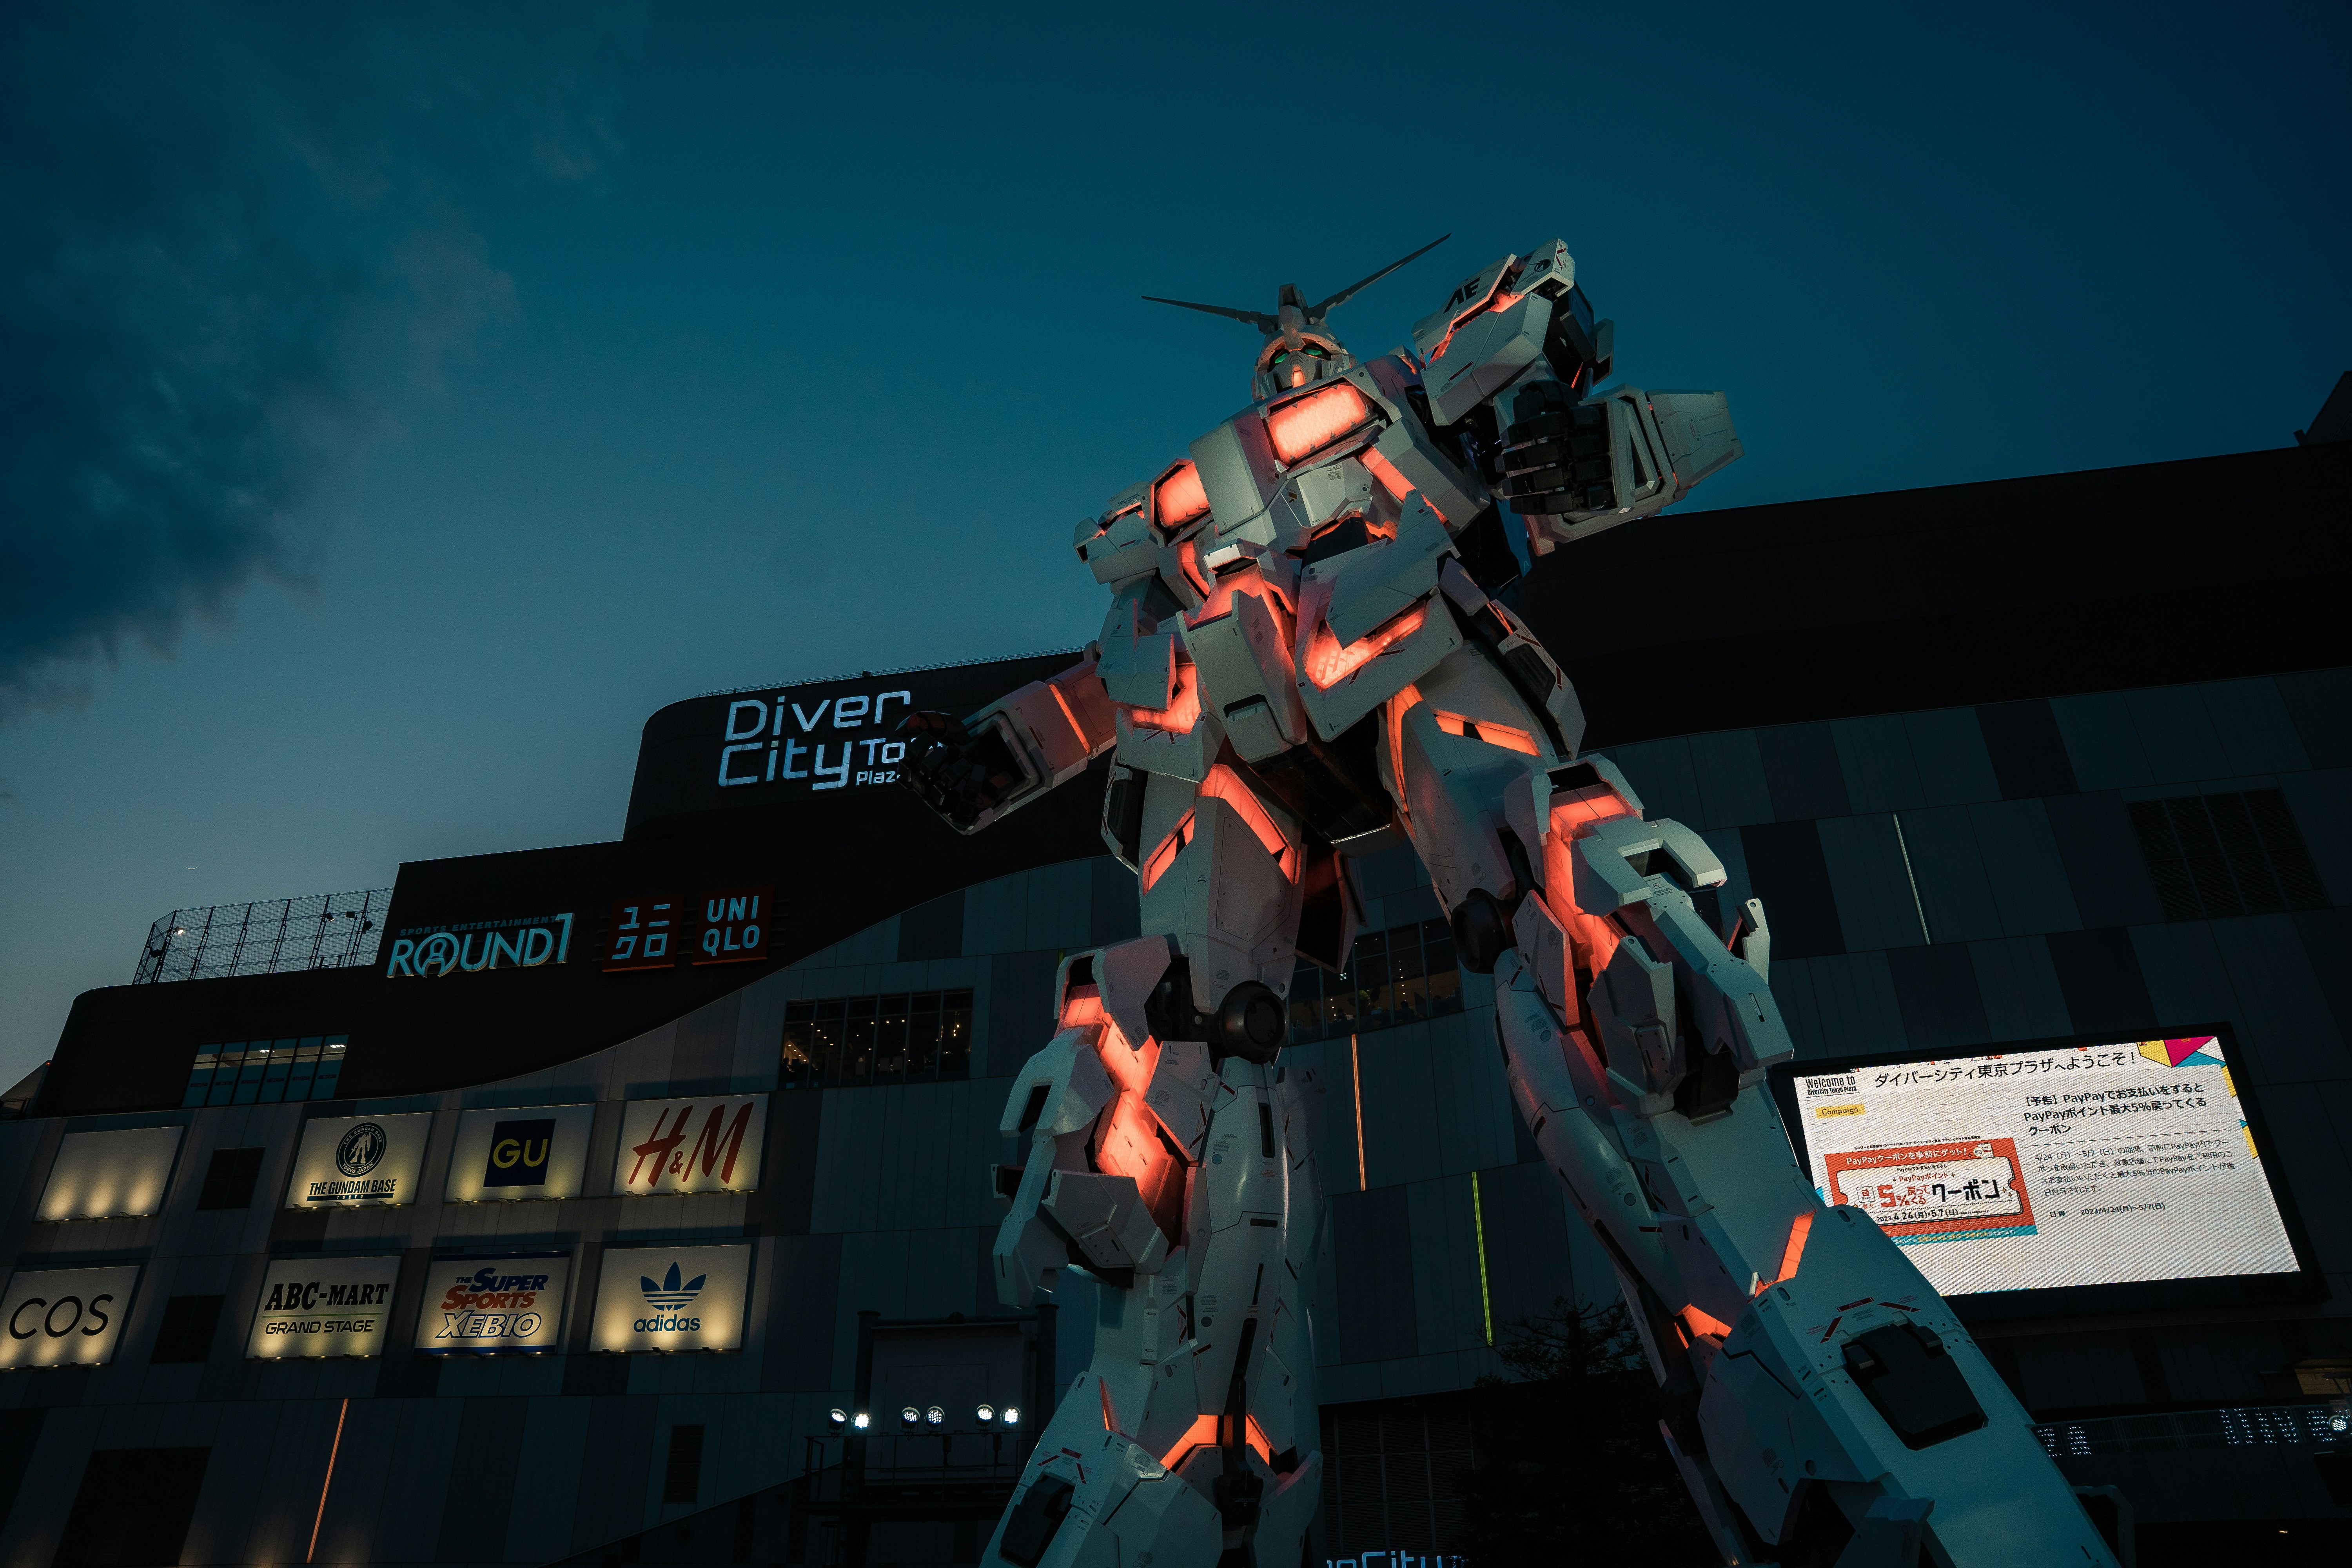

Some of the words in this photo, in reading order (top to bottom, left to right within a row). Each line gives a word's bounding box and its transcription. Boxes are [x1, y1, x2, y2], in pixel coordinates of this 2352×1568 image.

[724, 690, 911, 741] Diver
[718, 738, 853, 793] City
[855, 769, 901, 787] Plaz
[707, 895, 759, 922] UNI
[399, 925, 447, 936] SPORTS
[452, 915, 557, 931] ENTERTAINMENT
[387, 912, 575, 978] ROUND1
[702, 925, 760, 956] QLO
[1805, 1077, 1844, 1089] Welcome
[1846, 1075, 1856, 1085] to
[1875, 1051, 2135, 1088] ダイバーシティ東京プラザへようこそ！
[343, 1134, 352, 1145] THE
[354, 1127, 375, 1135] GUNDAM
[374, 1130, 383, 1143] BASE
[2028, 1123, 2071, 1136] クーポン
[492, 1138, 548, 1169] GU
[628, 1102, 754, 1187] H&M
[1846, 1147, 1967, 1165] PayPayクーポンを事前にゲット！
[342, 1163, 356, 1174] TOKYO
[357, 1162, 374, 1174] JAPAN
[1899, 1172, 1949, 1182] PayPayポイント
[309, 1182, 328, 1195] THE
[328, 1180, 370, 1195] GUNDAM
[370, 1179, 397, 1193] BASE
[1932, 1179, 2000, 1203] クーポン
[456, 1276, 473, 1284] THE
[470, 1267, 549, 1292] SUPER
[263, 1282, 390, 1311] ABC-MART
[440, 1284, 537, 1310] SPORTS
[8, 1294, 114, 1340] COS
[265, 1321, 321, 1334] GRAND
[323, 1319, 375, 1333] STAGE
[434, 1310, 543, 1339] XEBIO
[633, 1314, 701, 1332] adidas
